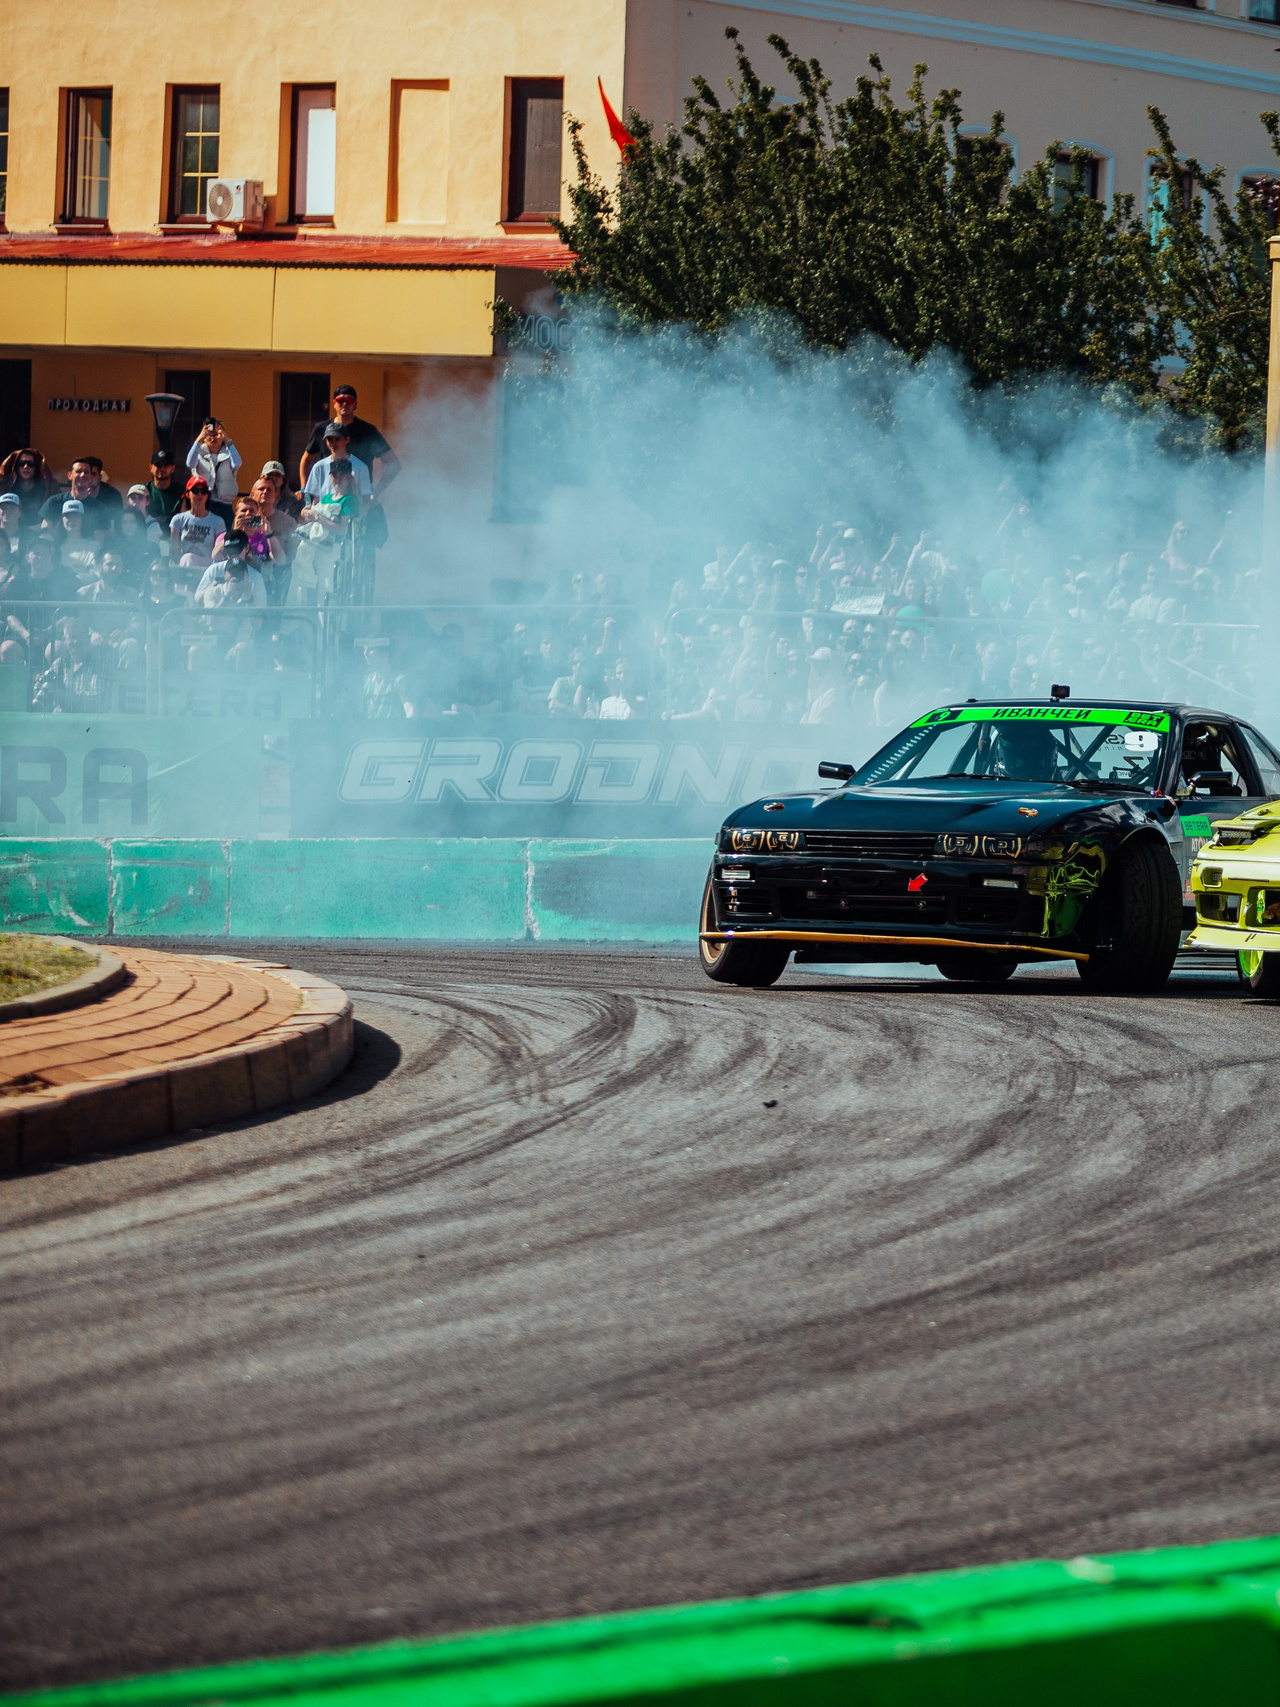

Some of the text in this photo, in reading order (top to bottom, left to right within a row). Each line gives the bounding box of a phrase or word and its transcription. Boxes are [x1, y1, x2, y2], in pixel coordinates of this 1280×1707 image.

[48, 399, 126, 412] ПРОХОДНАЯ
[937, 711, 951, 721] 9
[1124, 731, 1158, 752] 9
[337, 737, 823, 806] GRODNO
